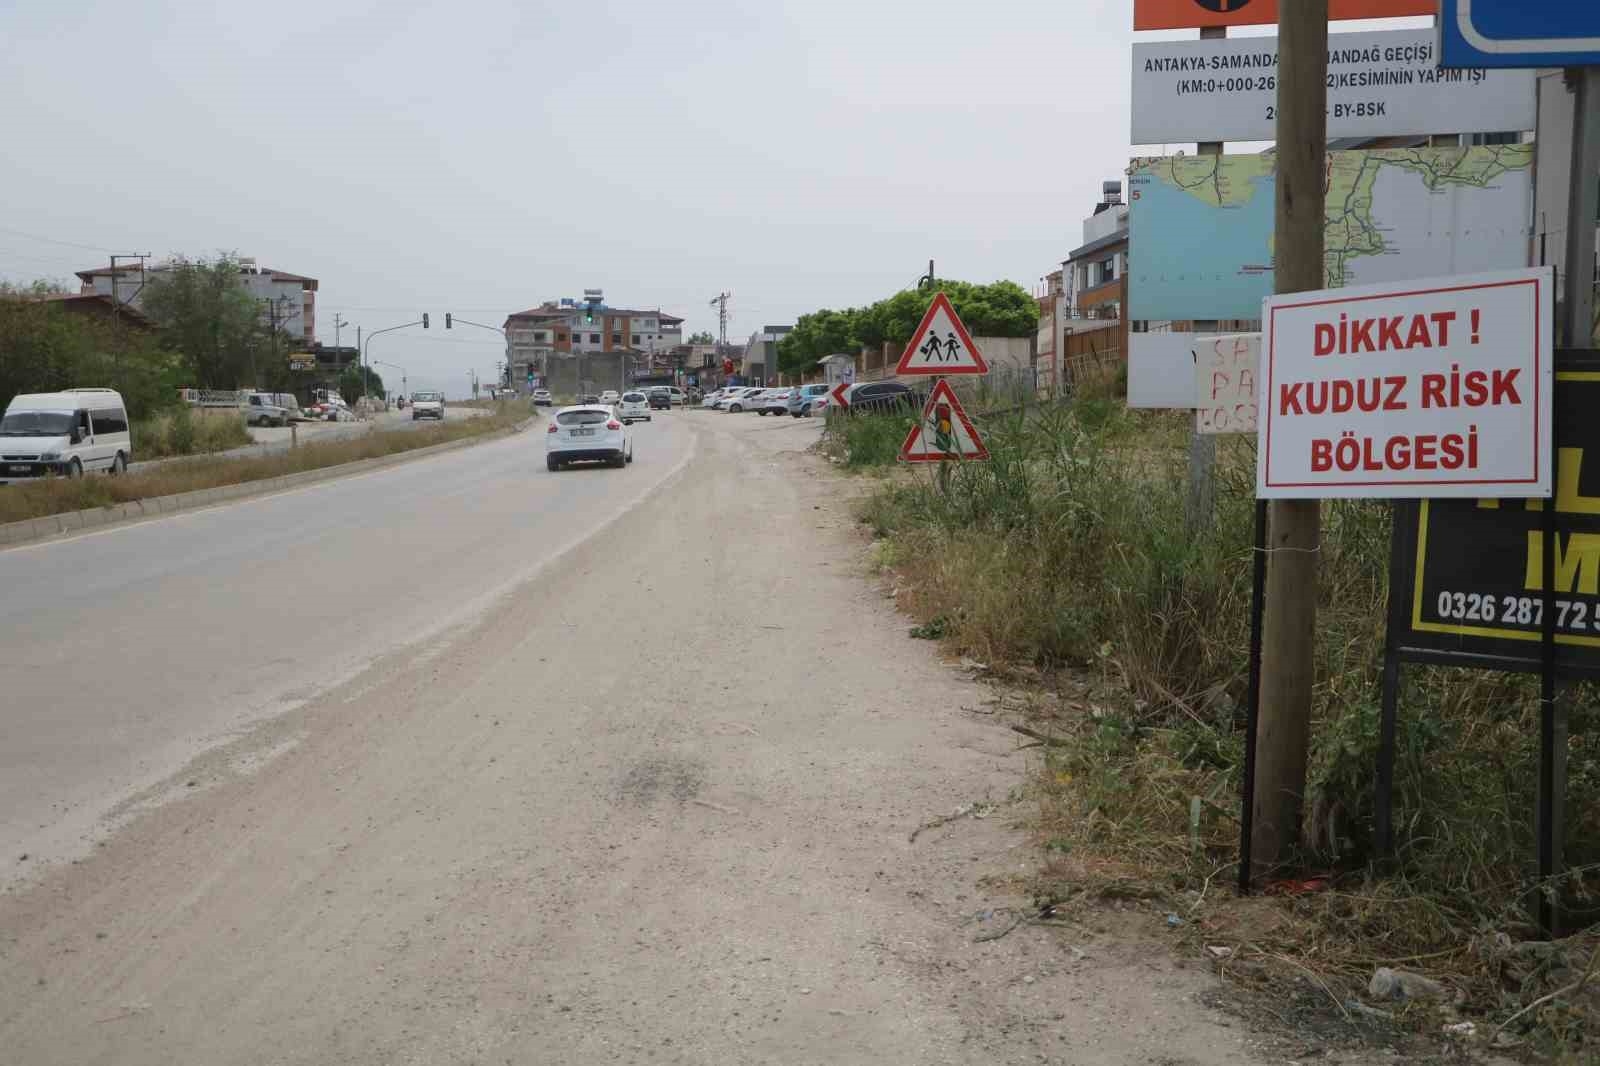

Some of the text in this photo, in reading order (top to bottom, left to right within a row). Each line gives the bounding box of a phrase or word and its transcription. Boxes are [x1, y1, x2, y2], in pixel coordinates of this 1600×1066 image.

[1384, 42, 1433, 65] GEÇİŞİ
[1334, 102, 1386, 118] BY-BSK
[1313, 310, 1456, 356] DİKKAT
[1279, 363, 1523, 416] KUDUZ RİSK
[1311, 425, 1479, 473] BÖLGESİ
[1438, 591, 1496, 621] 0326
[1501, 597, 1543, 625] 287
[1555, 600, 1588, 629] 72
